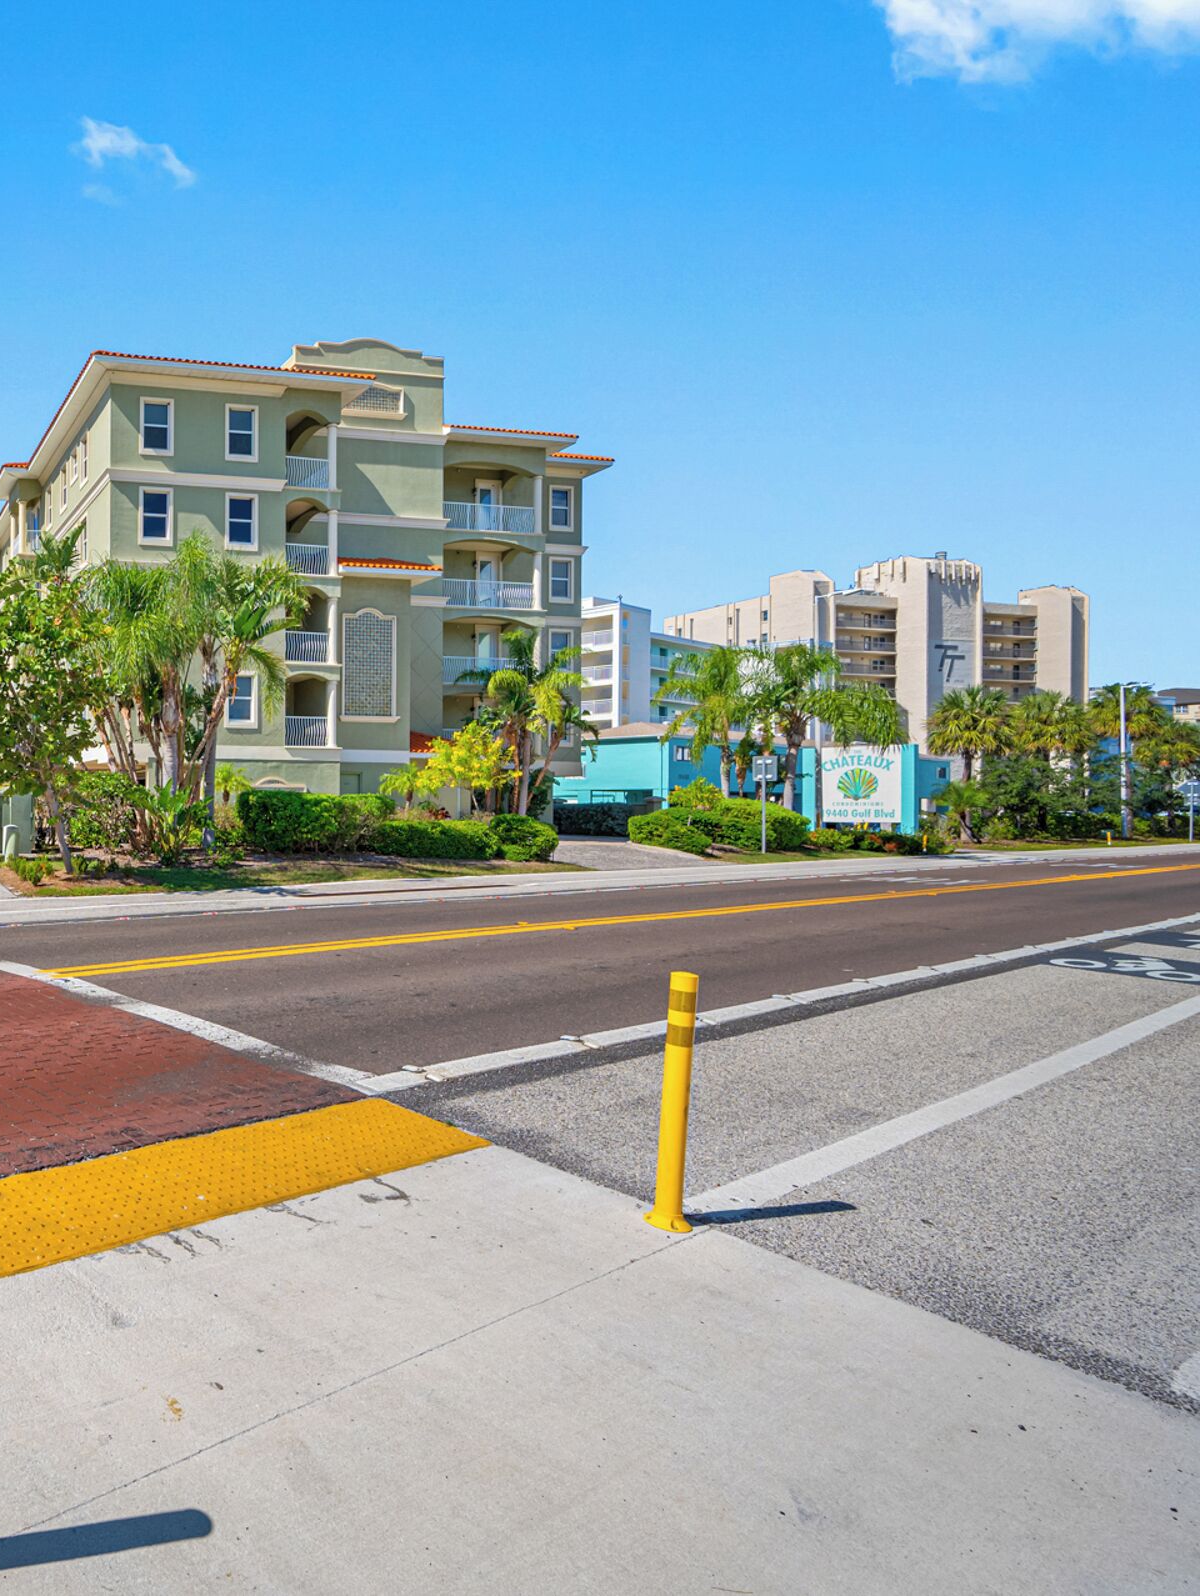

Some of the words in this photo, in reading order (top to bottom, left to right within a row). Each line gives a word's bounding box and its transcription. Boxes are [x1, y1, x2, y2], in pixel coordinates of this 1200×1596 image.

[821, 754, 895, 772] CHATEAUX
[851, 808, 871, 818] Gulf
[874, 808, 896, 819] Blvd
